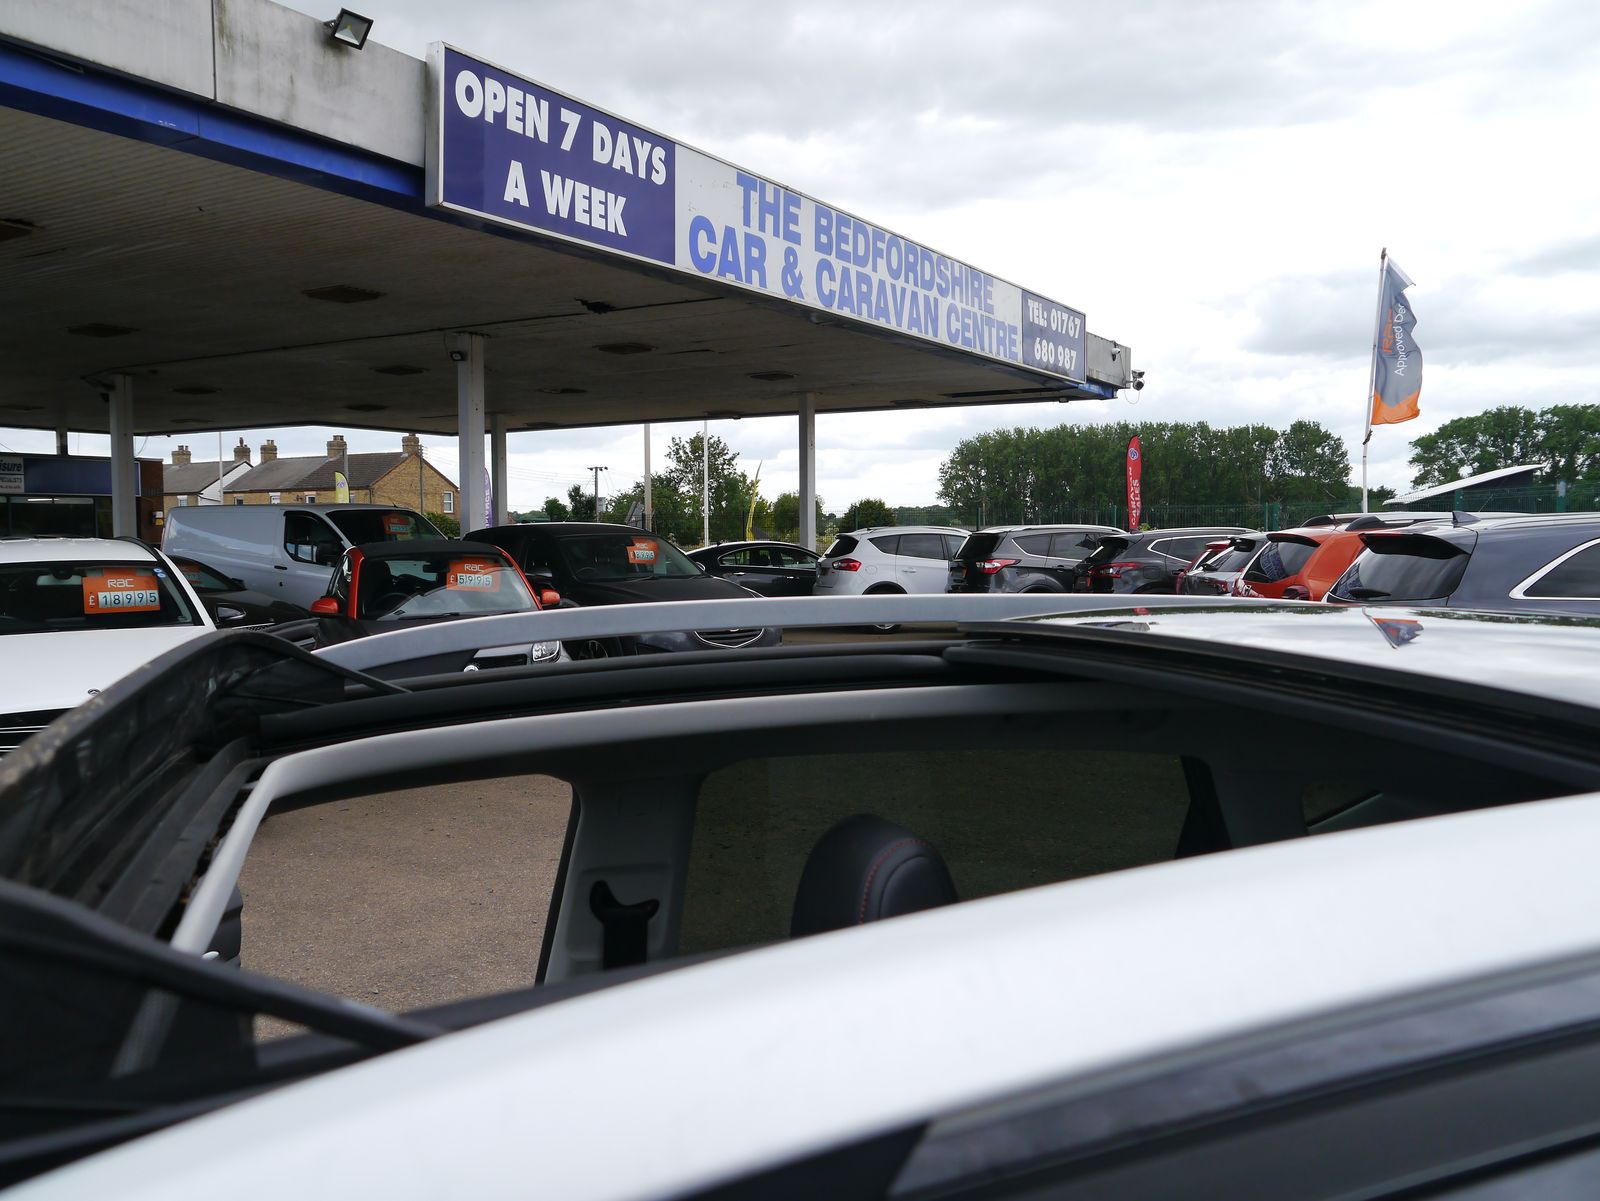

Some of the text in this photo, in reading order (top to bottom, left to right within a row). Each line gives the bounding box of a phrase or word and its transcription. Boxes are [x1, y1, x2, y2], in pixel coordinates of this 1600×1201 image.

[455, 70, 666, 185] OPEN 7 DAYS
[503, 160, 627, 237] A WEEK
[736, 171, 995, 315] THE BEDFORDSHIRE
[689, 215, 1019, 363] CAR & CARAVAN CENTRE
[1028, 299, 1081, 339] TEL: 01767
[1034, 337, 1077, 371] 680 987
[1393, 325, 1407, 376] Approved
